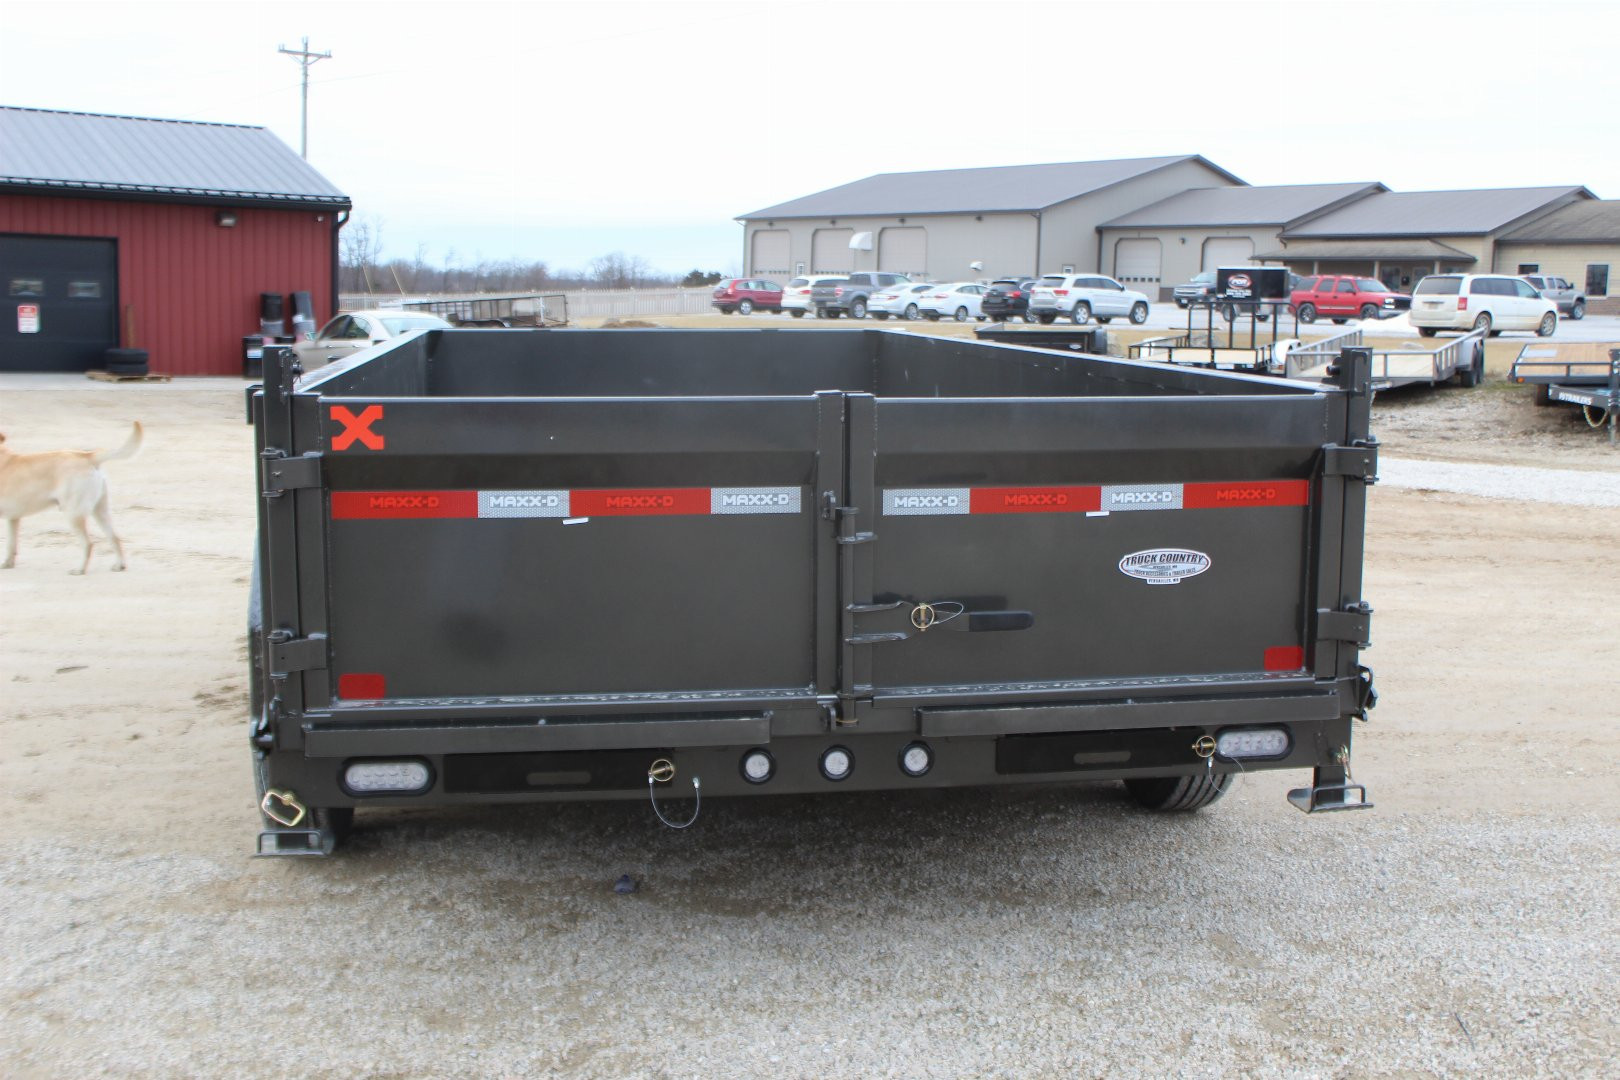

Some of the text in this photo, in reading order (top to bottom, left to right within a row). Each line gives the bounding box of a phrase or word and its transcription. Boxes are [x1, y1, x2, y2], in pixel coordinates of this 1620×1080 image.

[330, 405, 385, 451] X
[369, 494, 789, 508] MAXX-D MAXX-D MAXX-D MAXX-D
[894, 488, 1276, 508] MAXX-D MAXX-D MAXX-D MAXX-D
[1125, 553, 1206, 566] TRUCK COUNTRY
